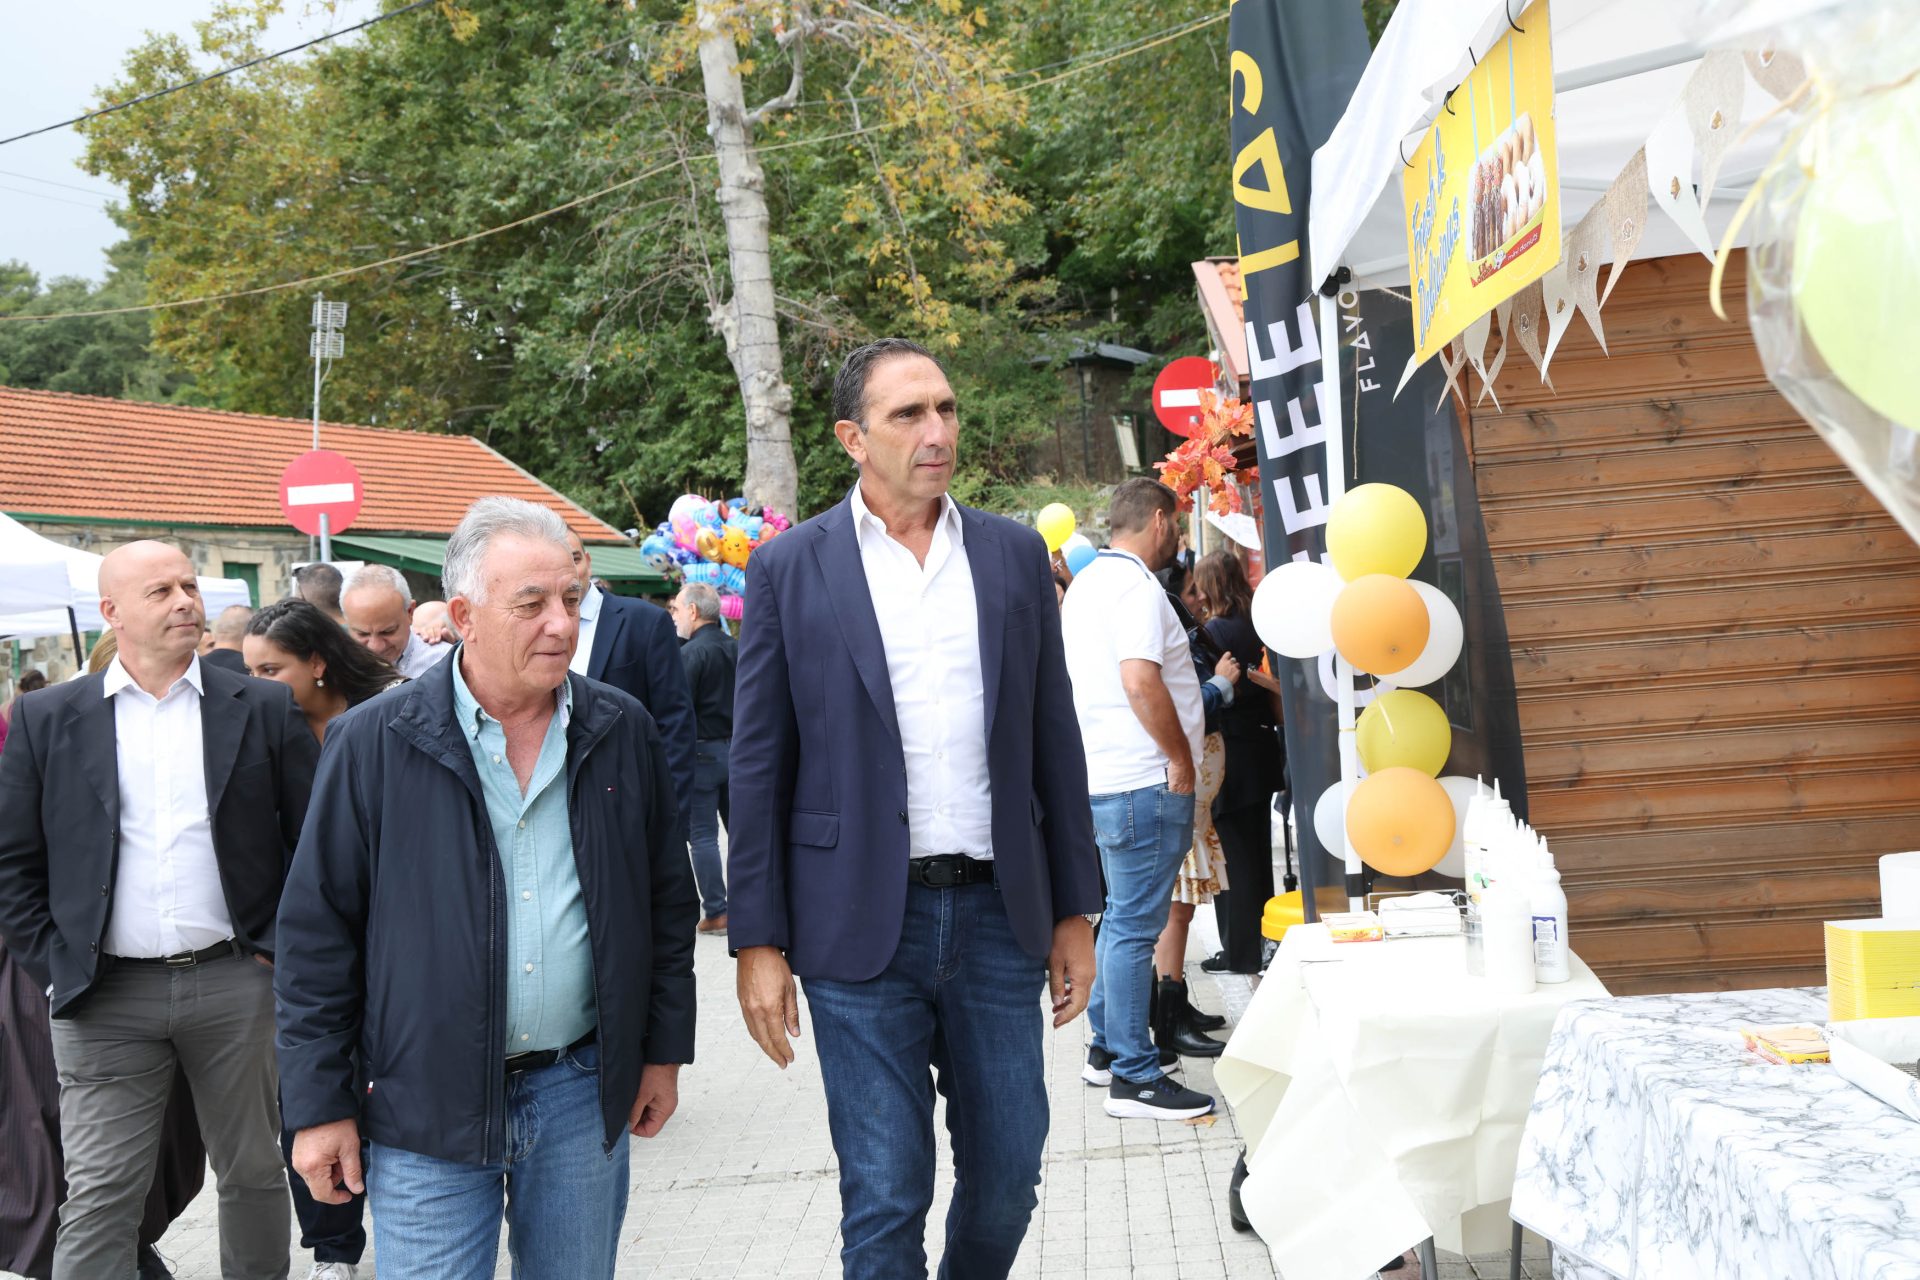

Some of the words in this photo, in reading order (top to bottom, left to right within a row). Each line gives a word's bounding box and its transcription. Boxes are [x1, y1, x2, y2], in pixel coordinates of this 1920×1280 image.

[1230, 0, 1300, 301] TAS
[1412, 156, 1437, 276] Fresh
[1417, 196, 1460, 349] Delicious
